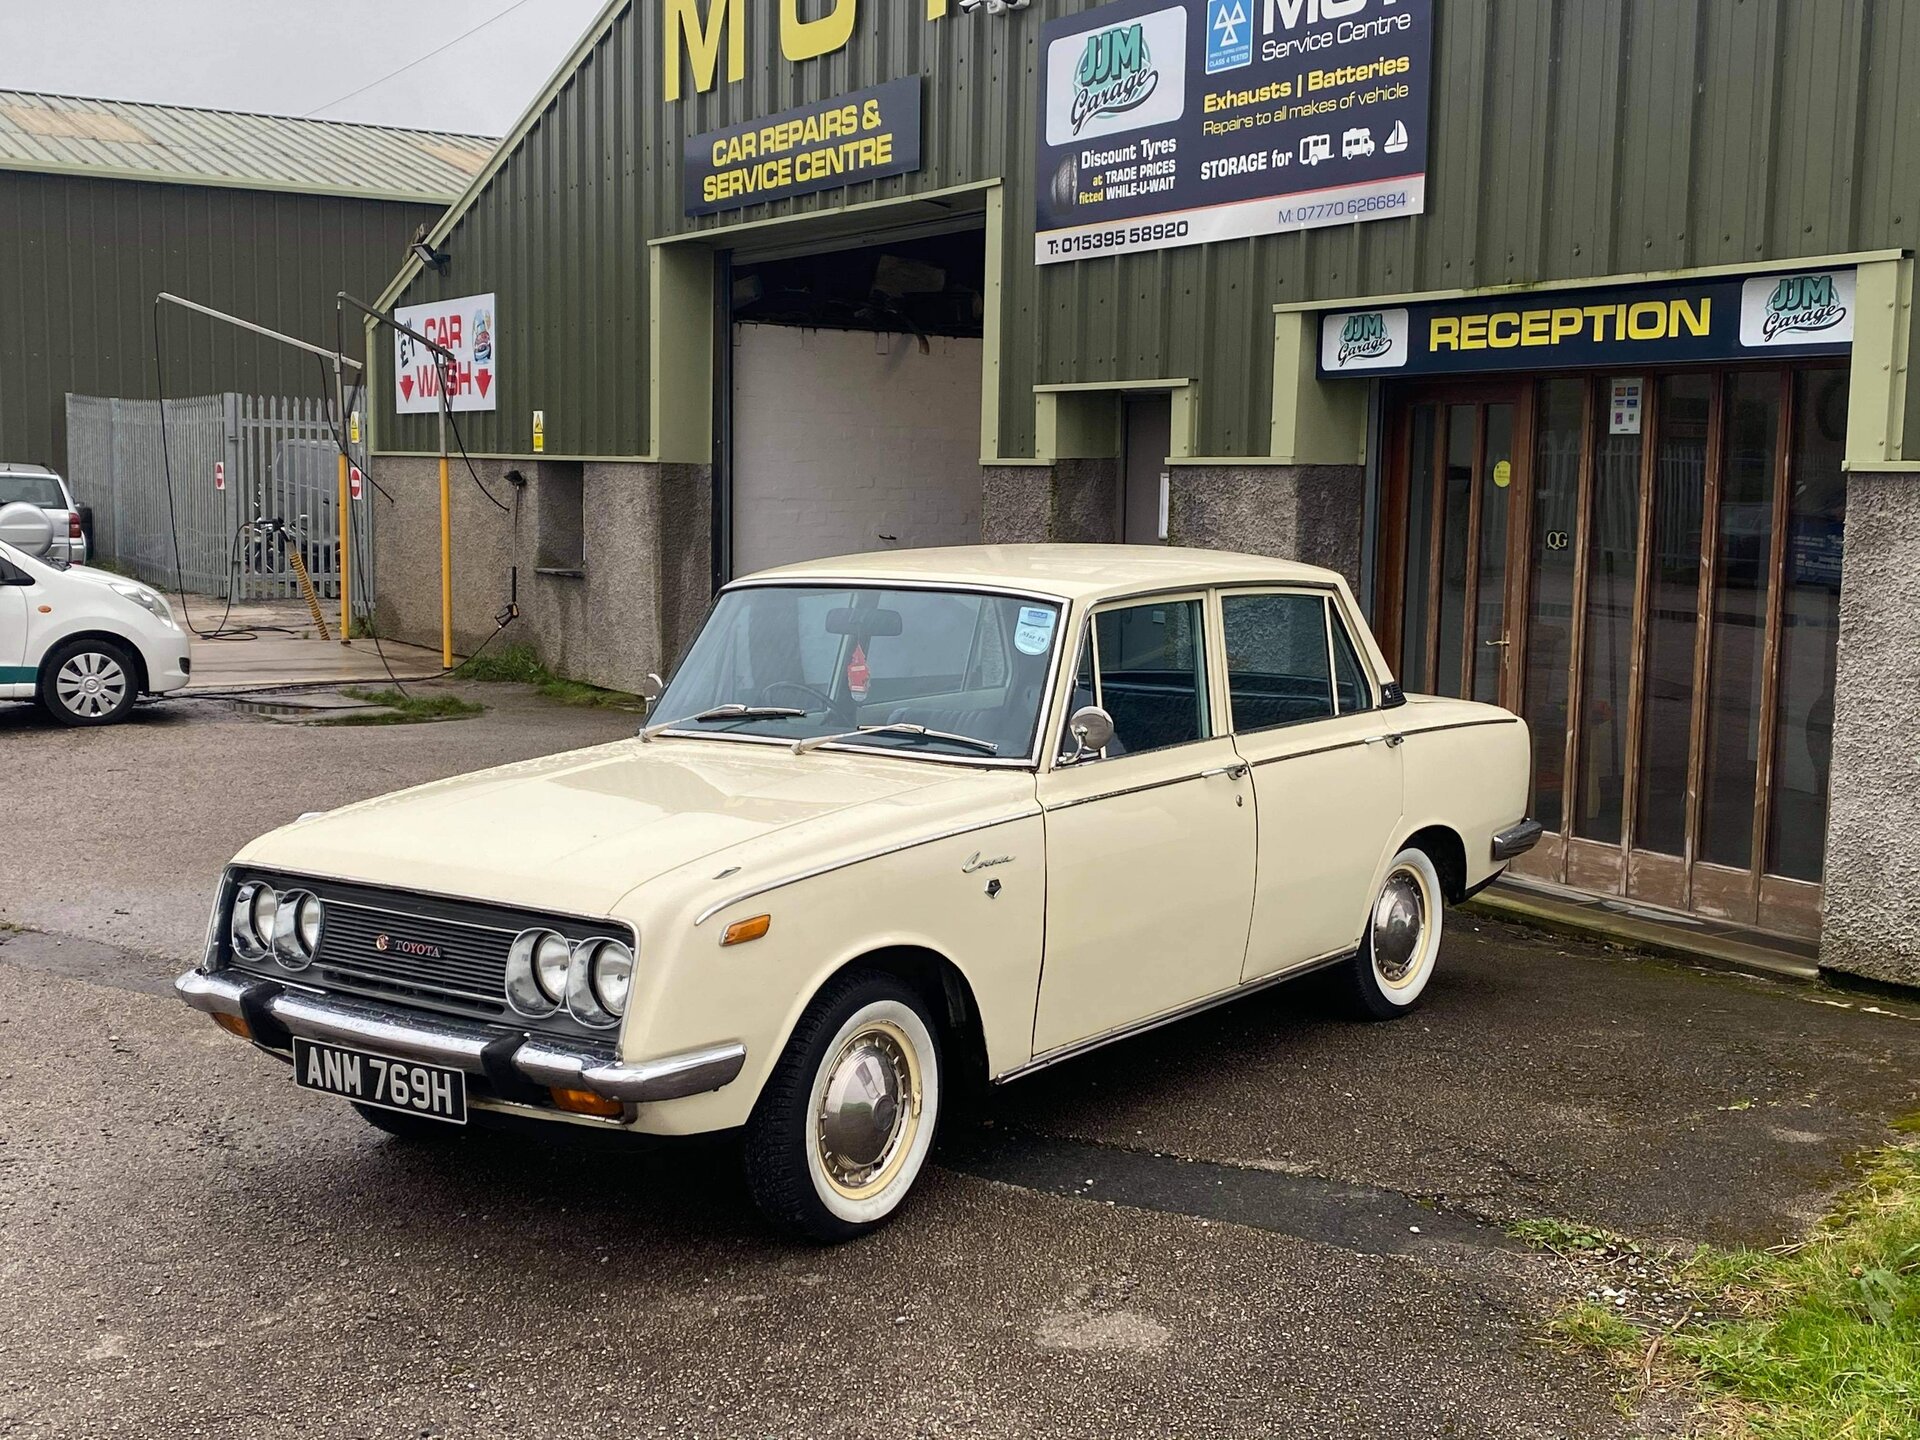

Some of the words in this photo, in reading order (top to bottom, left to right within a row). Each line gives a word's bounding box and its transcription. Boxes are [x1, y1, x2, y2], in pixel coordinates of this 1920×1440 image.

[1081, 23, 1143, 87] JJM
[1262, 31, 1333, 61] Service
[1337, 13, 1411, 44] Centre
[1071, 68, 1158, 136] Garage
[1203, 80, 1292, 114] Exhausts
[1308, 56, 1410, 92] Batteries
[1203, 112, 1253, 136] Repairs
[1256, 112, 1271, 126] to
[1274, 106, 1287, 121] all
[1289, 98, 1337, 119] makes
[1340, 92, 1355, 109] of
[1357, 83, 1408, 105] vehicle
[712, 132, 757, 168] CAR
[760, 104, 858, 156] REPAIRS
[862, 99, 882, 130] &
[703, 156, 792, 203] SERVICE
[795, 133, 893, 183] CENTRE
[1081, 144, 1136, 170] Discount
[1140, 138, 1177, 161] Tyres
[1200, 151, 1267, 181] STORAGE
[1271, 148, 1293, 169] for
[1079, 189, 1104, 205] fitted
[1106, 176, 1176, 200] WHILE-U-WAIT
[1093, 174, 1103, 187] at
[1105, 166, 1137, 184] TRADE
[1139, 160, 1176, 178] PRICES
[1278, 209, 1293, 224] M:
[1296, 201, 1344, 221] 07770
[1347, 192, 1407, 214] 626684
[1047, 240, 1059, 255] T:
[1061, 229, 1126, 253] 015395
[1129, 220, 1189, 244] 58920
[1773, 275, 1833, 312] JJM
[424, 315, 461, 351] CAR
[1343, 313, 1385, 344] JJM
[1429, 297, 1712, 352] RECEPTION
[1762, 304, 1847, 343] Garage
[1337, 337, 1393, 368] Garage
[395, 940, 441, 958] TOYOTA
[307, 1047, 362, 1096] ANM
[369, 1059, 453, 1115] 769H
